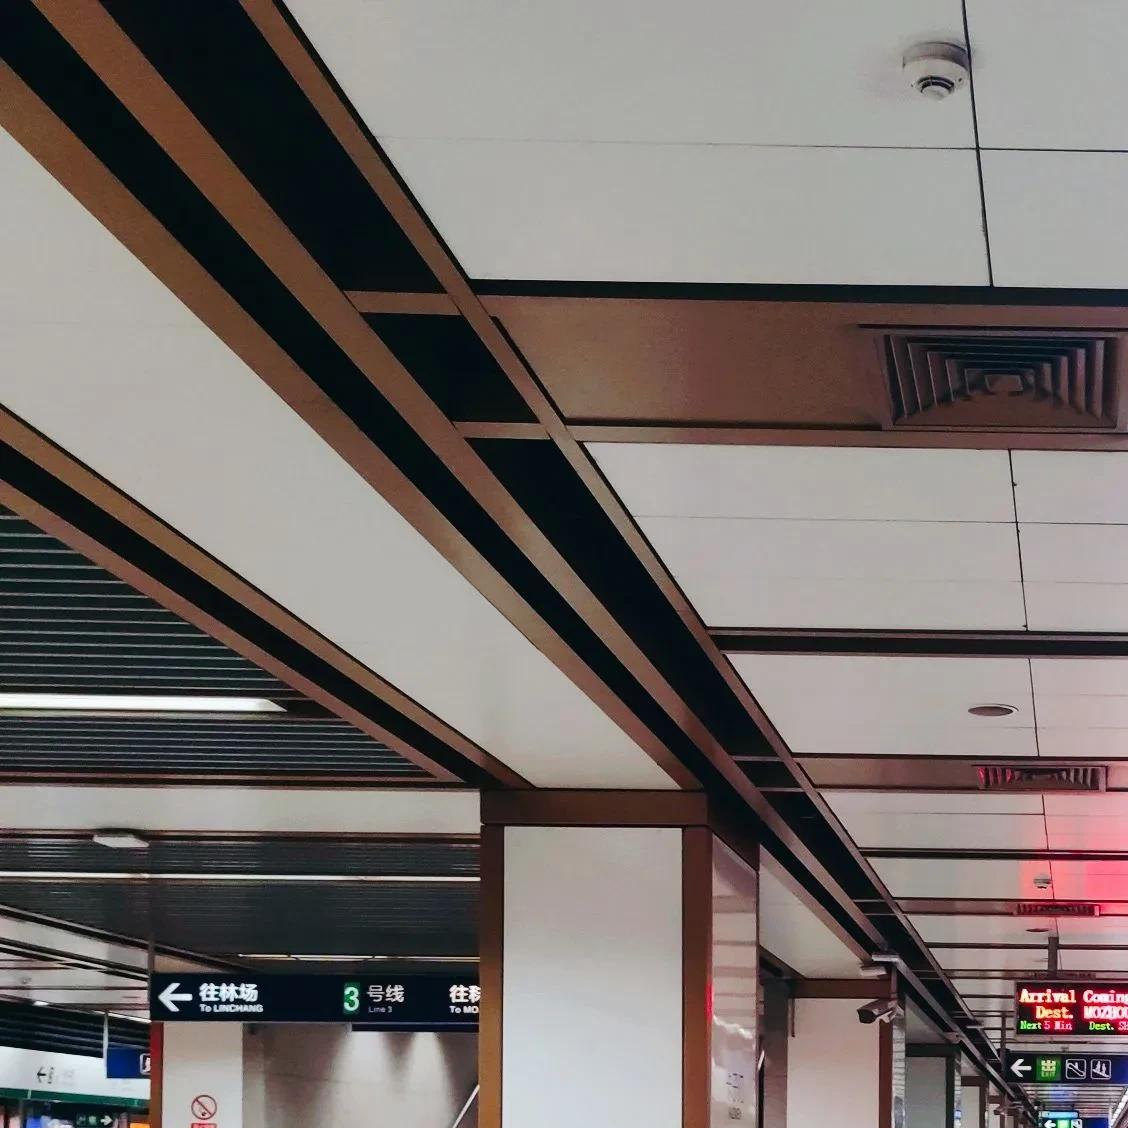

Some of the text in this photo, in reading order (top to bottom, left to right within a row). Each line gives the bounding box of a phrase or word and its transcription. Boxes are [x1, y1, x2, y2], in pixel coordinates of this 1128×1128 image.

[199, 983, 258, 1002] 往林场
[344, 984, 405, 1011] 3 号线
[1020, 989, 1077, 1003] Arrival
[199, 1004, 264, 1012] To LINCHANG
[449, 1005, 462, 1013] To
[1035, 1005, 1074, 1019] Dest.
[1020, 1020, 1042, 1030] Next
[1044, 1021, 1051, 1030] 5
[1089, 1021, 1115, 1031] Dest.
